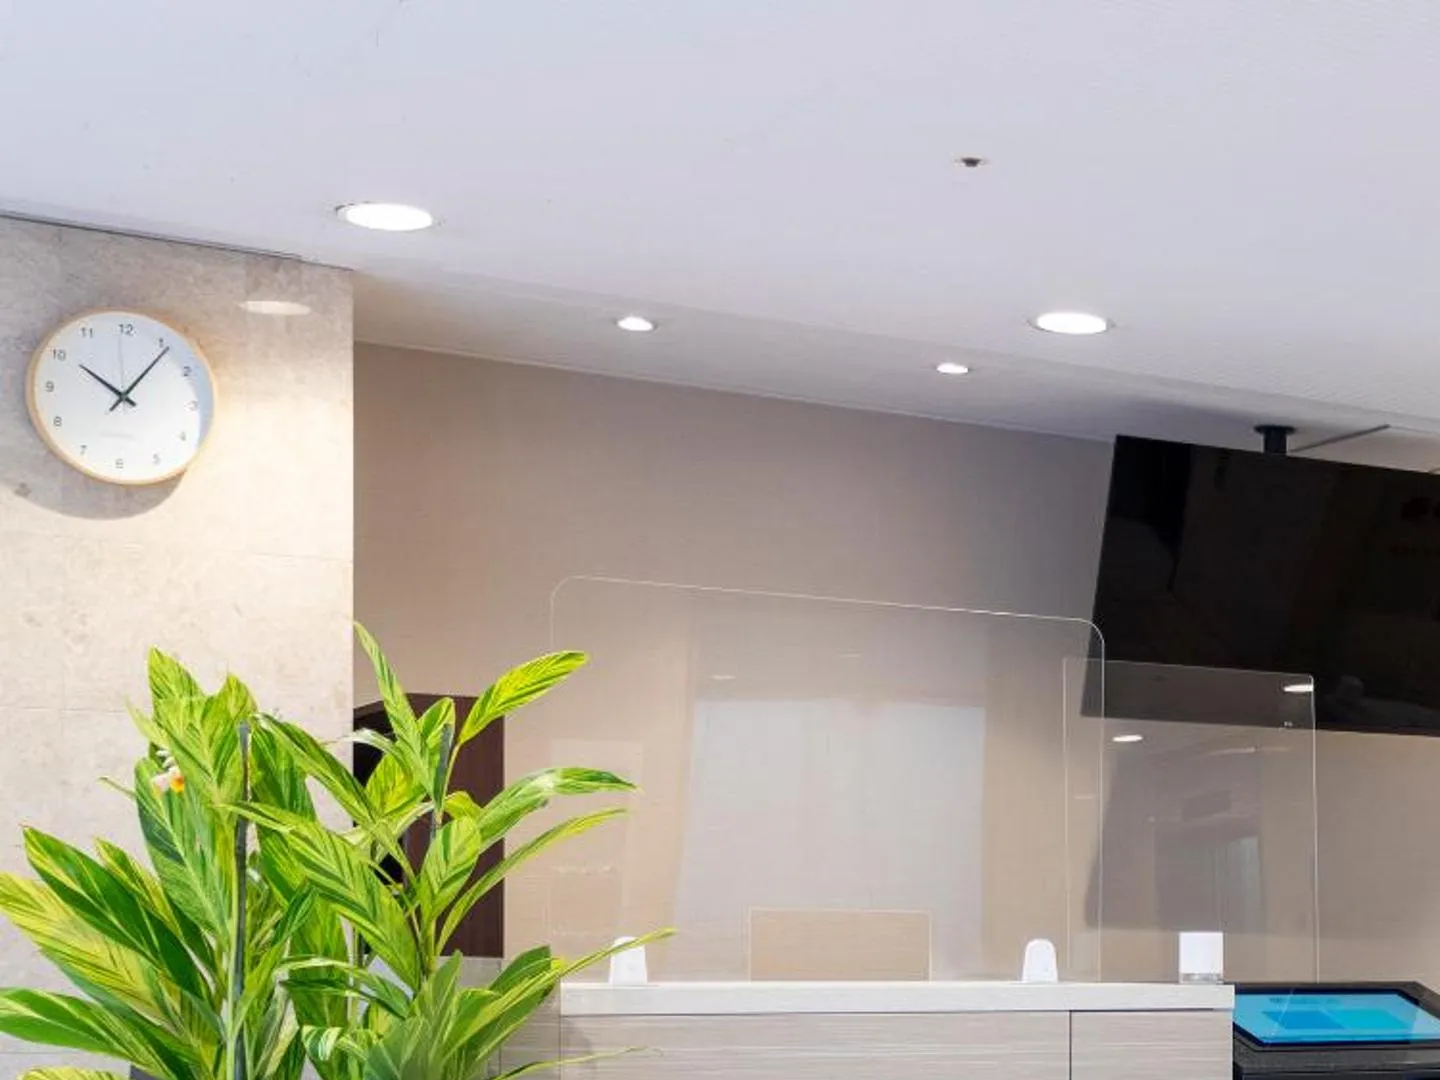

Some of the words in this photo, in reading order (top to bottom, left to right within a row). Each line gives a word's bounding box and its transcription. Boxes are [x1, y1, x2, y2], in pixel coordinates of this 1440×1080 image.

[80, 327, 94, 339] 11
[118, 323, 135, 337] 12
[52, 349, 67, 361] 10
[182, 366, 192, 378] 2
[45, 380, 55, 393] 9
[53, 416, 63, 427] 8
